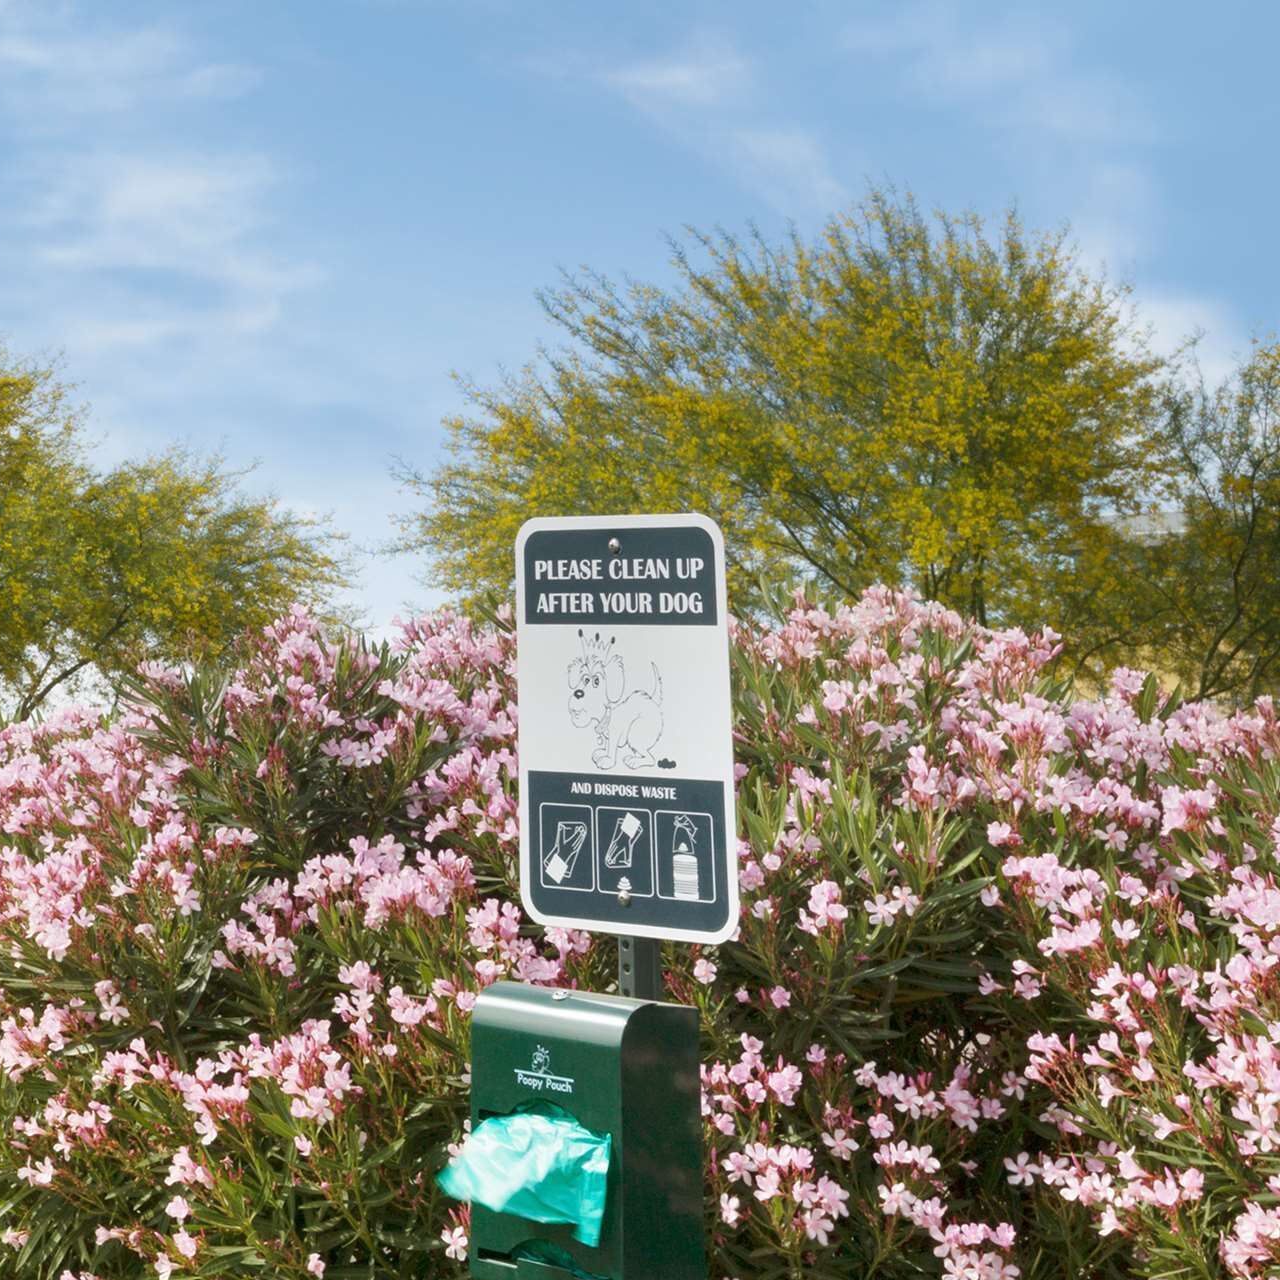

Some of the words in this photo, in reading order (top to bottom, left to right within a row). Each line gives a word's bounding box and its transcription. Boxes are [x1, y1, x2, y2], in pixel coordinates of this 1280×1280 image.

[534, 559, 603, 581] PLEASE
[608, 558, 670, 580] CLEAN
[676, 557, 704, 580] UP
[536, 592, 594, 614] AFTER
[599, 592, 653, 614] YOUR
[659, 592, 704, 614] DOG
[570, 782, 592, 795] AND
[594, 783, 639, 798] DISPOSE
[641, 786, 677, 800] WASTE
[517, 1072, 543, 1090] Poopy
[546, 1079, 572, 1093] Pouch
